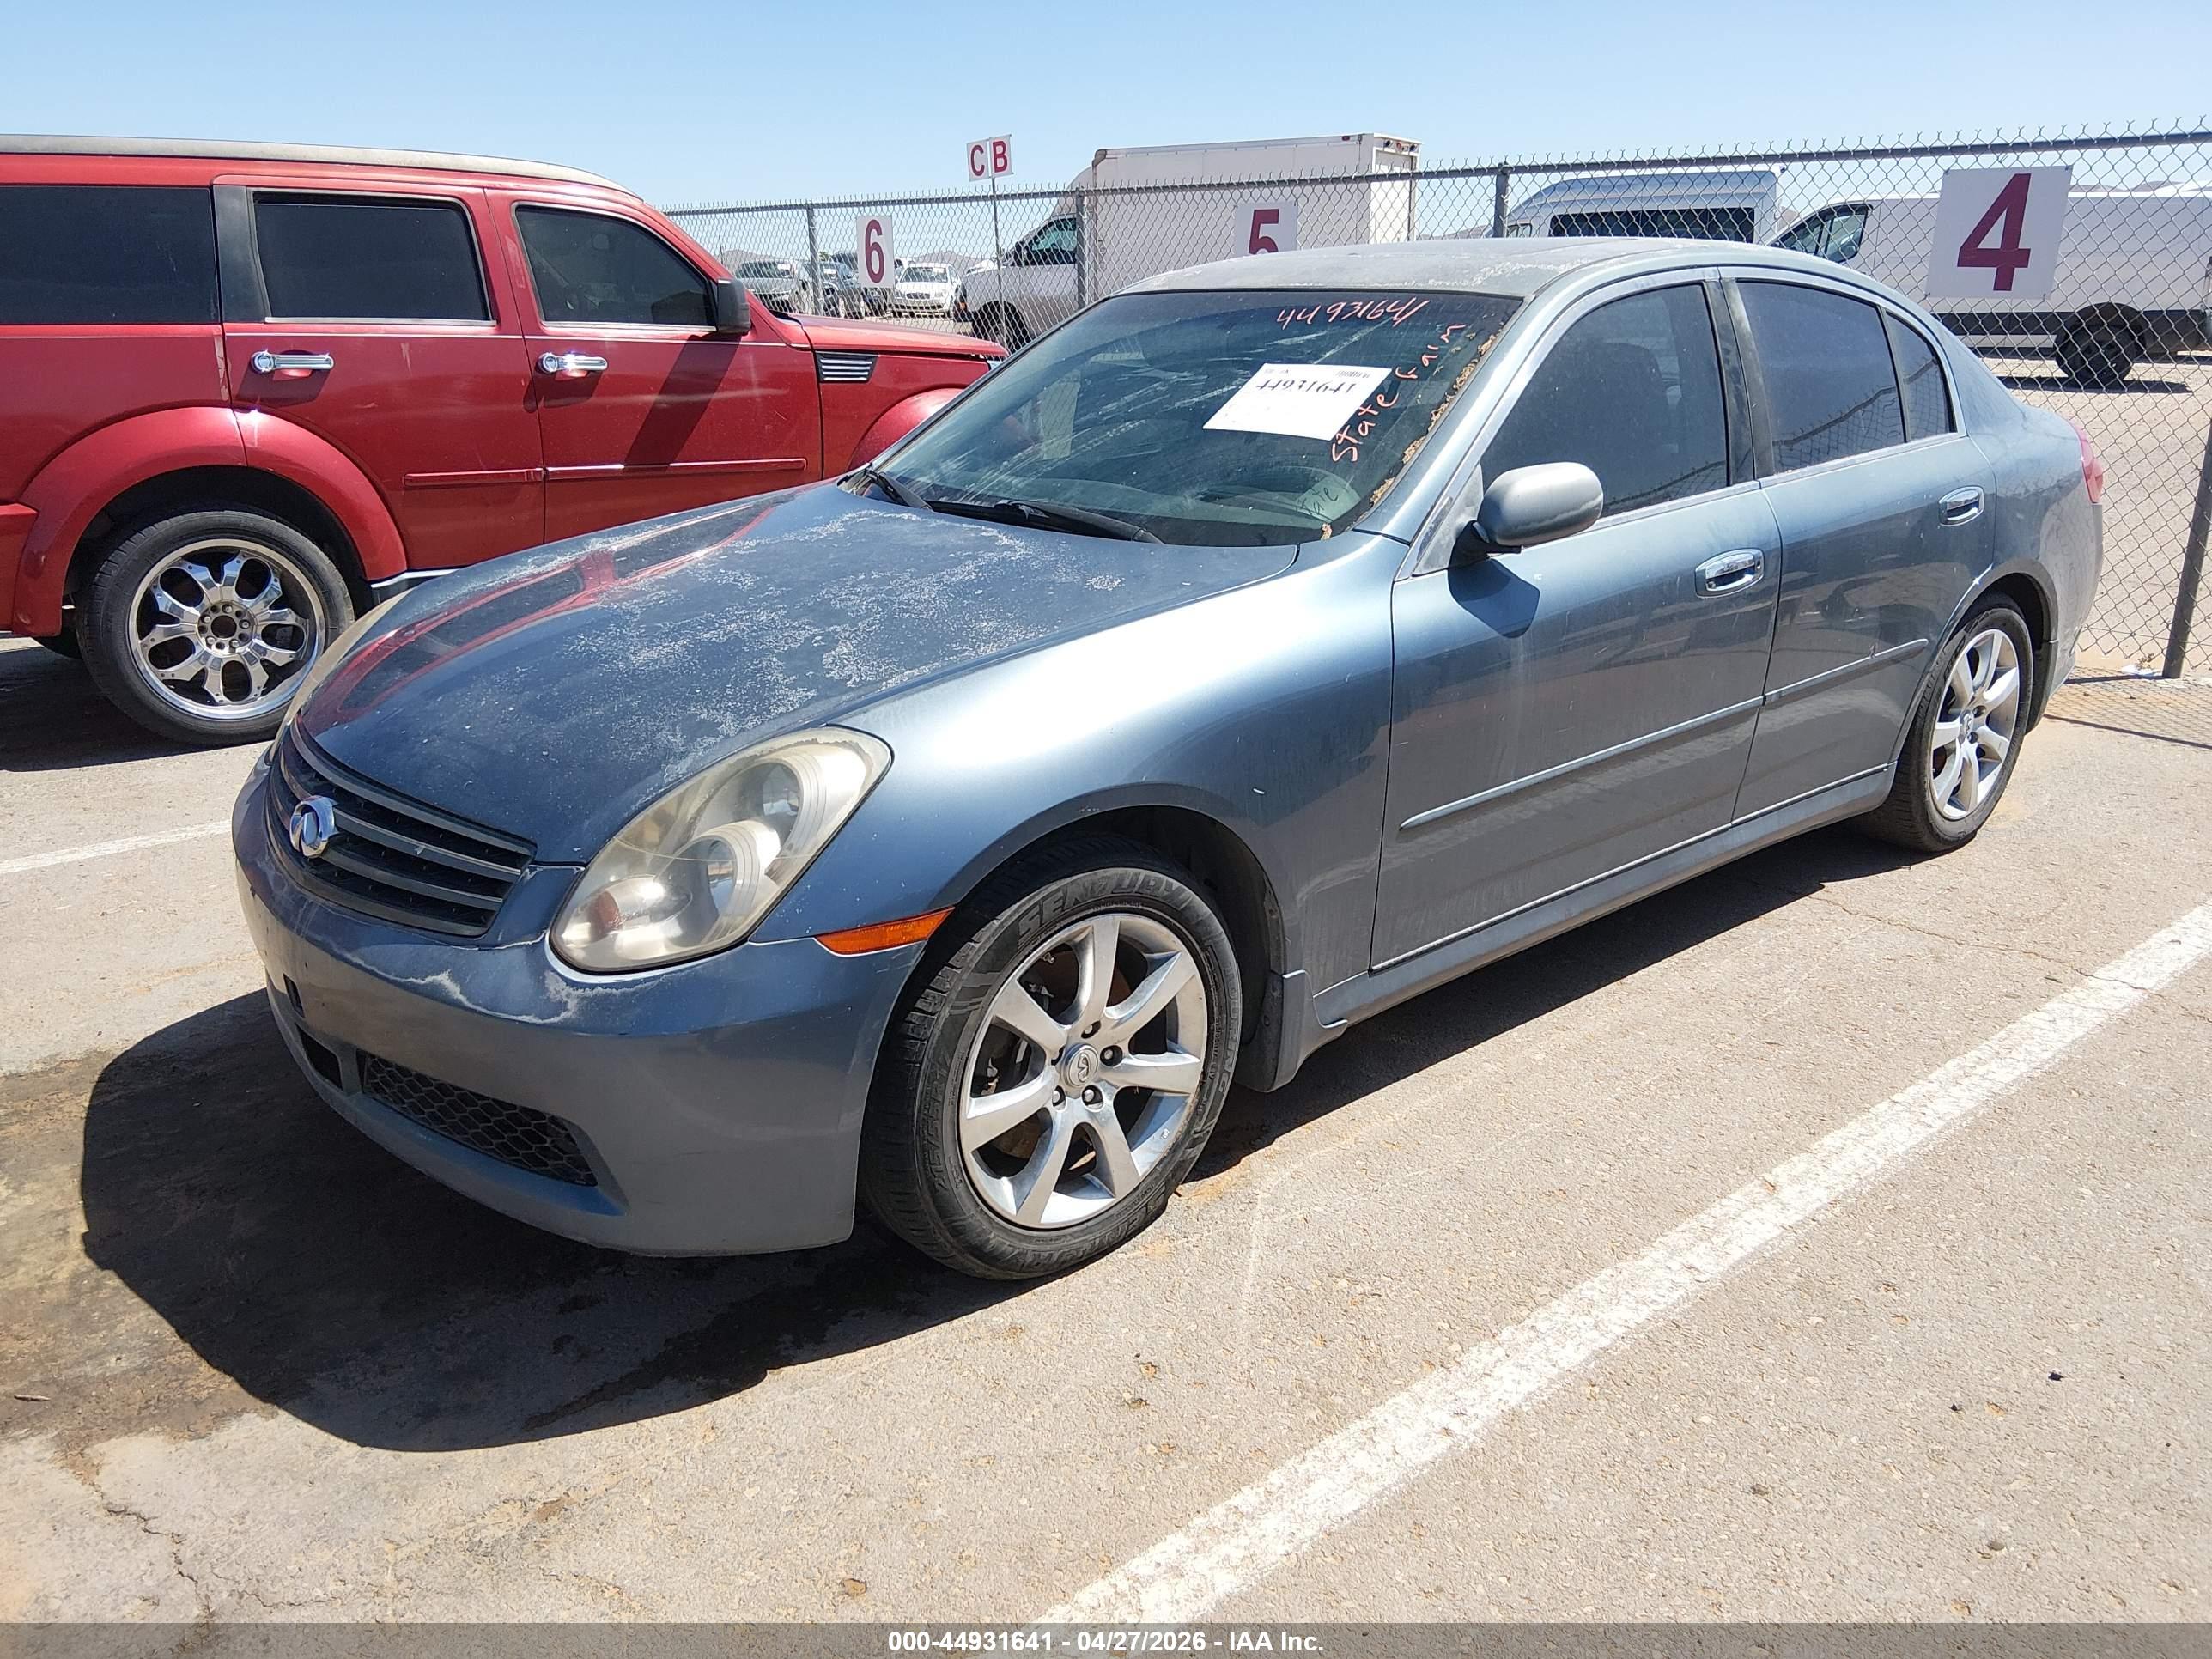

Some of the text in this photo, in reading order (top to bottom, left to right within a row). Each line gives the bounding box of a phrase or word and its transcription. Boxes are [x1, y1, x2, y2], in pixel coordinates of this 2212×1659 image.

[865, 219, 885, 283] 6
[1249, 209, 1279, 255] 5
[1958, 173, 2031, 292] 4
[1331, 392, 1400, 462] State
